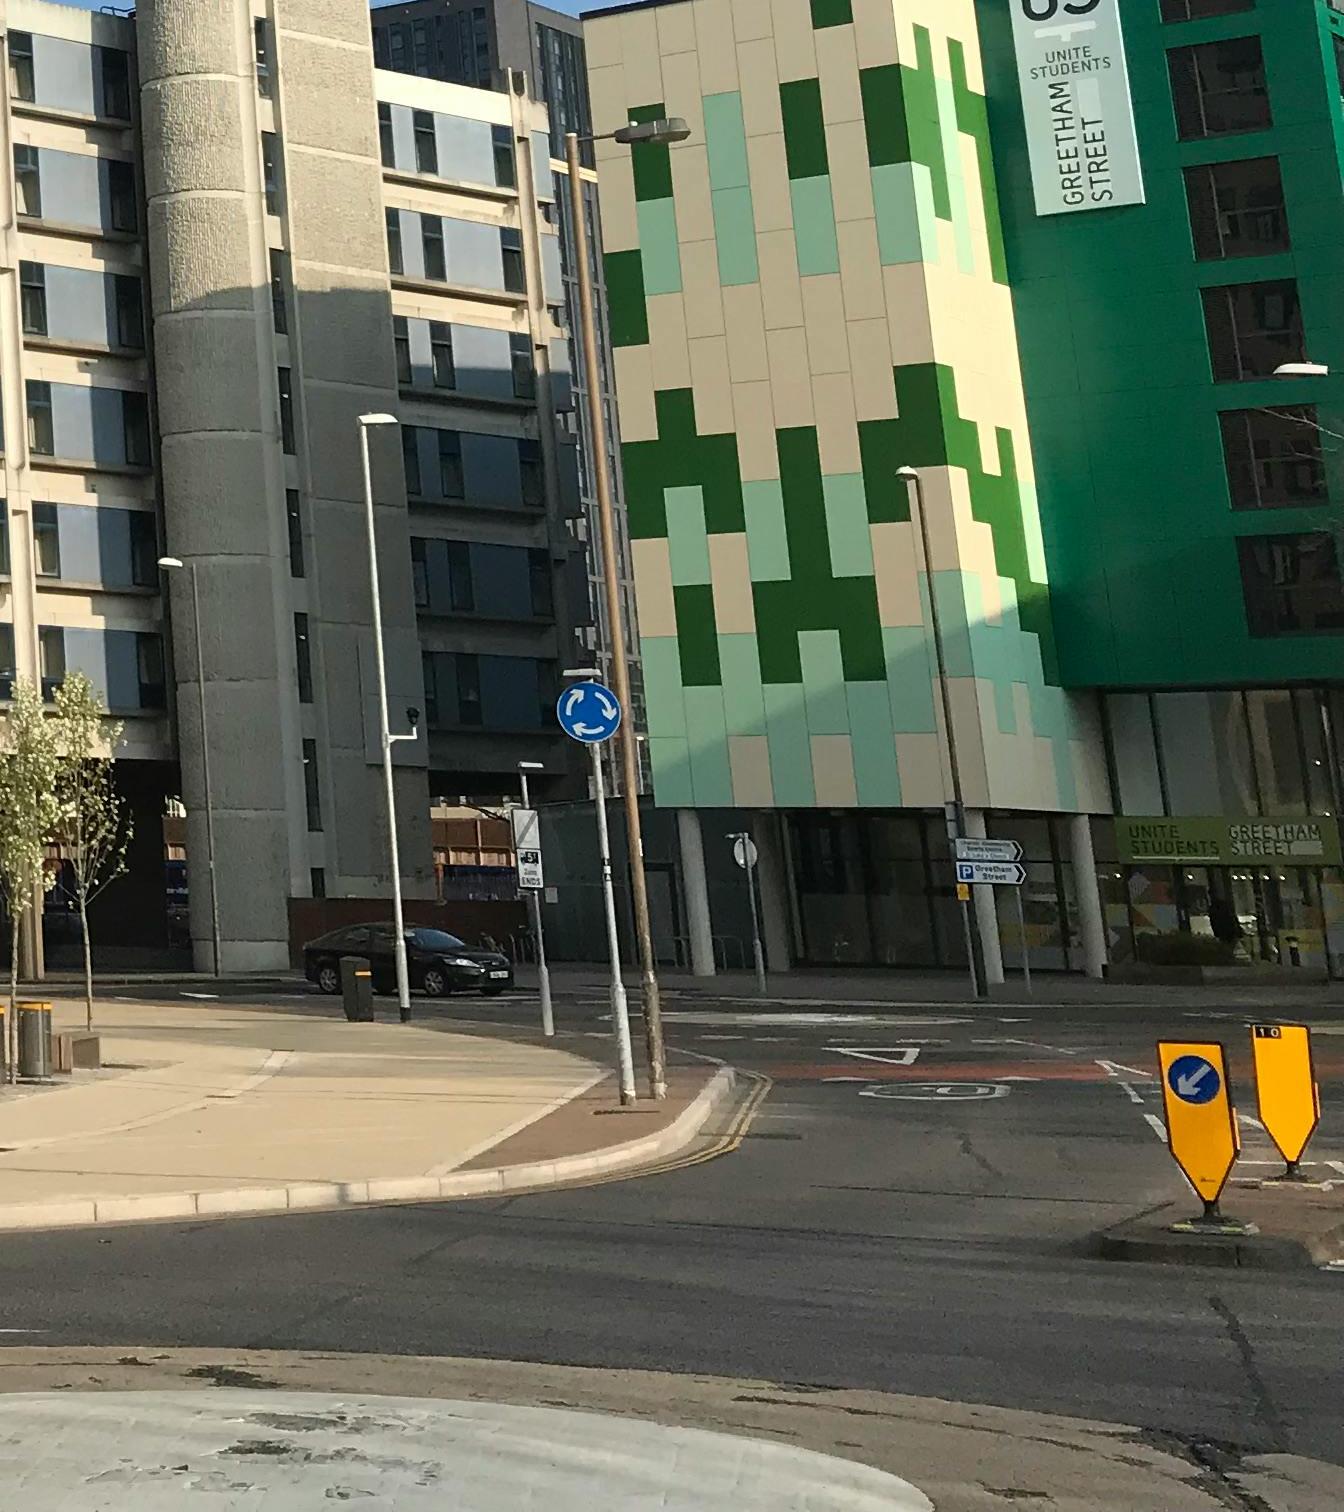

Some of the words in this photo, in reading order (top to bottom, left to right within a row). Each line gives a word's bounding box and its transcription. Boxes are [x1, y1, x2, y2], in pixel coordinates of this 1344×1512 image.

[1045, 45, 1092, 64] UNITE
[1030, 56, 1112, 80] STUDENTS
[1048, 81, 1084, 206] GREETHAM
[1081, 117, 1113, 202] STREET
[1129, 824, 1179, 838] UNITE
[1229, 824, 1322, 839] GREETHAM
[1130, 840, 1220, 855] STUDENTS
[1230, 840, 1292, 856] STREET
